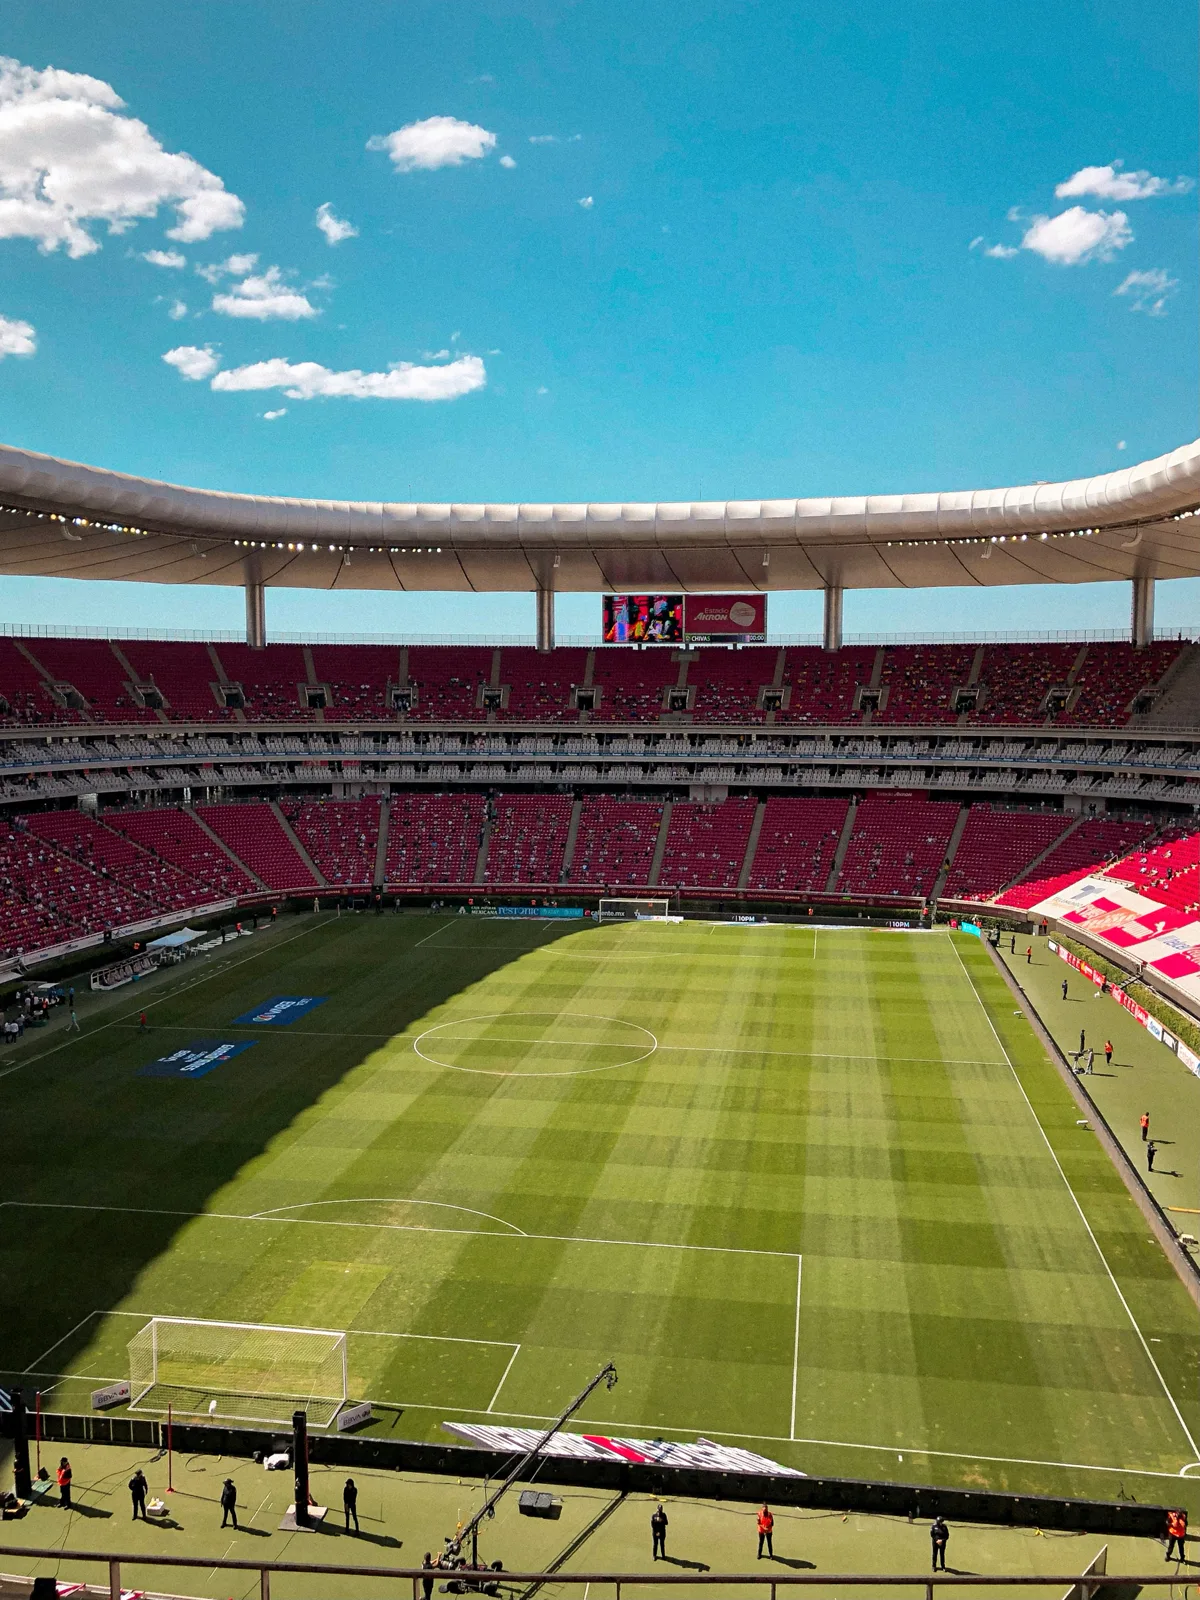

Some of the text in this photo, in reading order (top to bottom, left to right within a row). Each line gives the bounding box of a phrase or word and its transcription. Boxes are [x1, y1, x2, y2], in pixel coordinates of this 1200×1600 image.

[693, 612, 728, 621] AKRON
[98, 1392, 117, 1403] BBVA
[343, 1414, 361, 1426] BBVA
